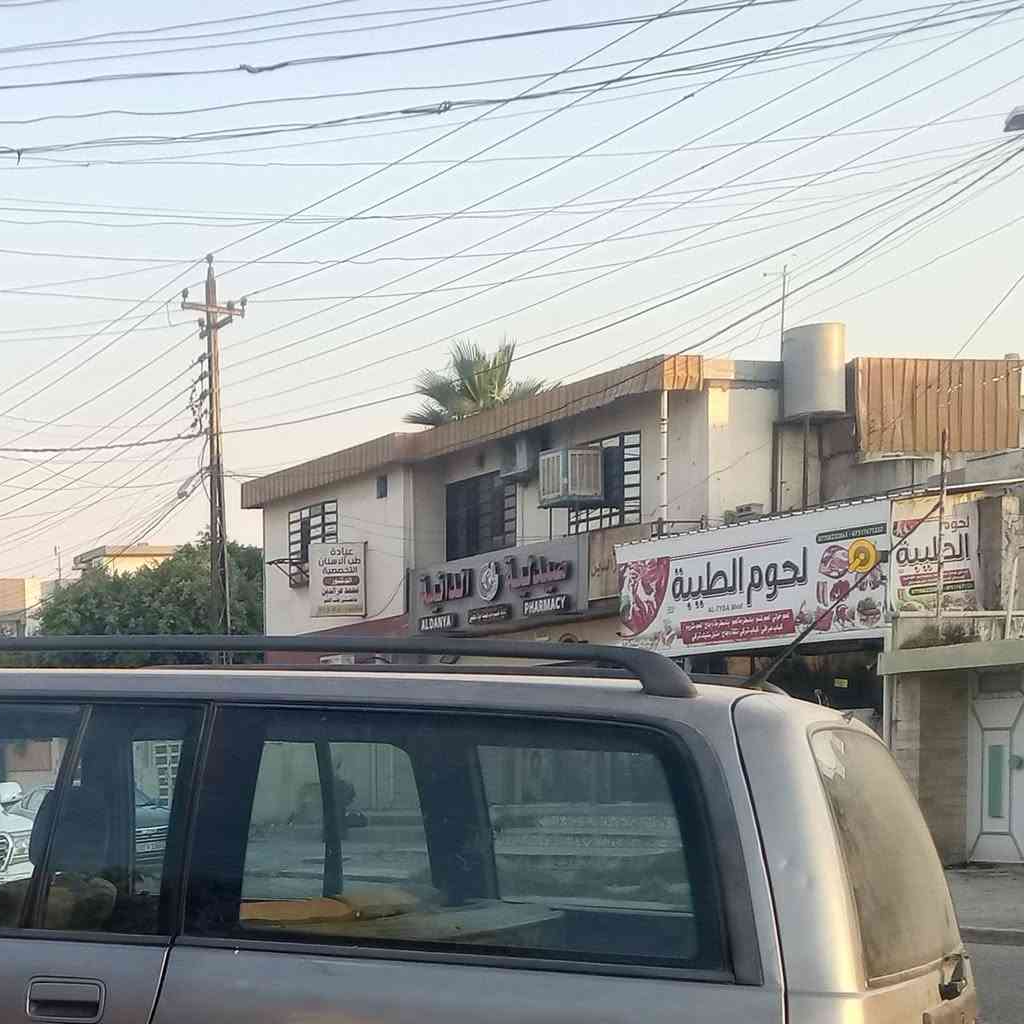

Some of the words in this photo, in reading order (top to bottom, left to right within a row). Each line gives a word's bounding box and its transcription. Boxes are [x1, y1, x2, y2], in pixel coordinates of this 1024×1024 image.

[895, 533, 970, 572] الطيبة
[504, 555, 569, 598] صيدلية
[671, 556, 743, 611] الطيبة
[746, 546, 808, 608] لحوم
[420, 615, 452, 631] ALDANYA
[523, 594, 567, 615] PHARMACY
